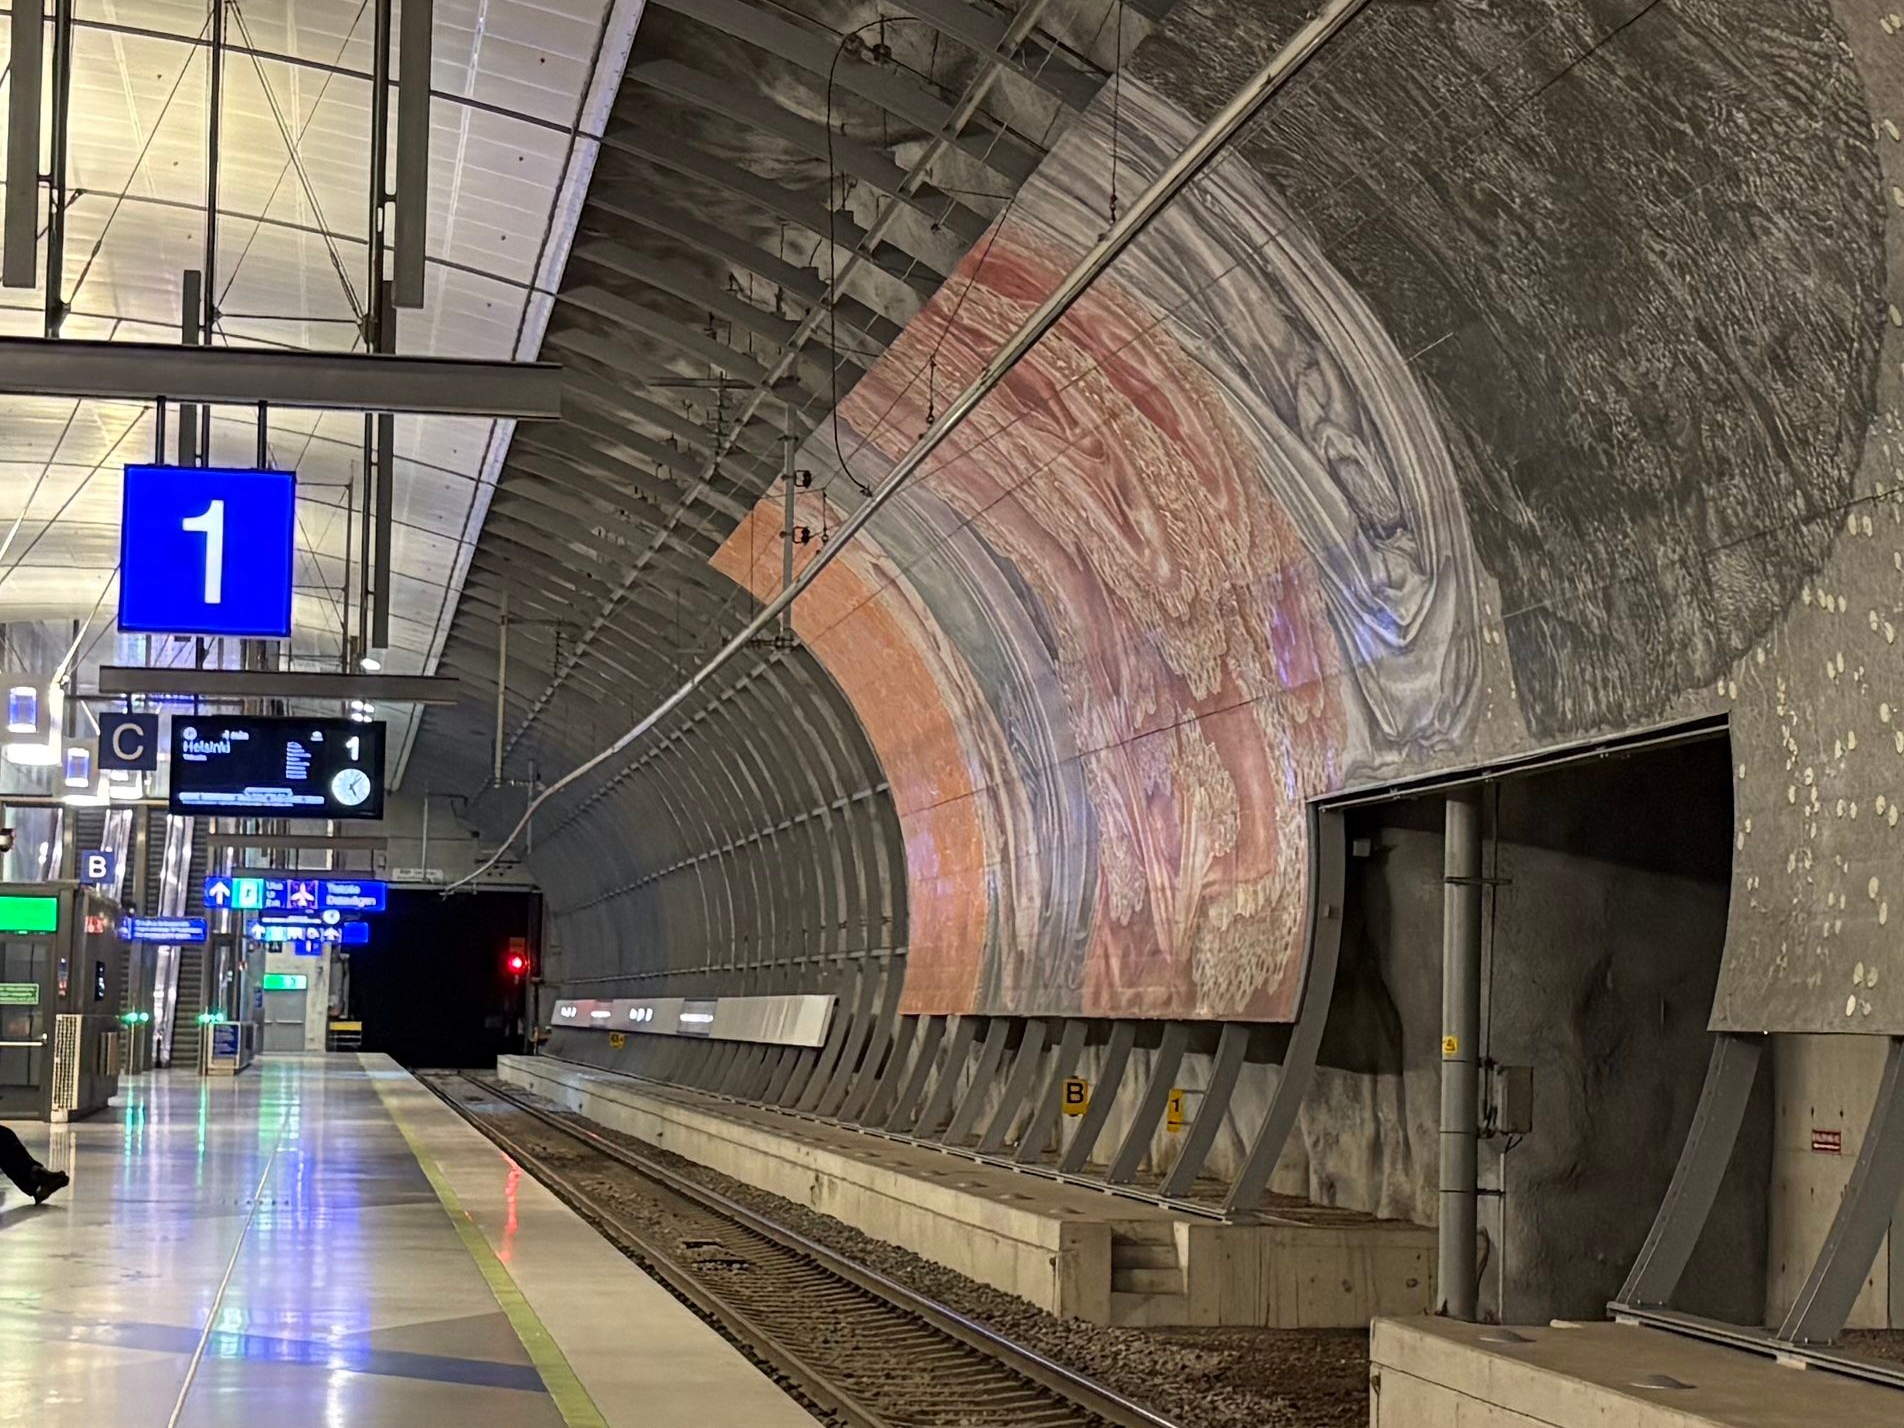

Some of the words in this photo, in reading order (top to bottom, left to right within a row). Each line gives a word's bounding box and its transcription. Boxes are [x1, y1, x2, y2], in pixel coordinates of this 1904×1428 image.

[181, 499, 225, 604] 1
[112, 723, 145, 761] C
[182, 740, 231, 754] Helsinki
[345, 736, 360, 761] 1
[88, 855, 107, 878] B
[1066, 1082, 1084, 1104] B
[1170, 1099, 1180, 1113] 1
